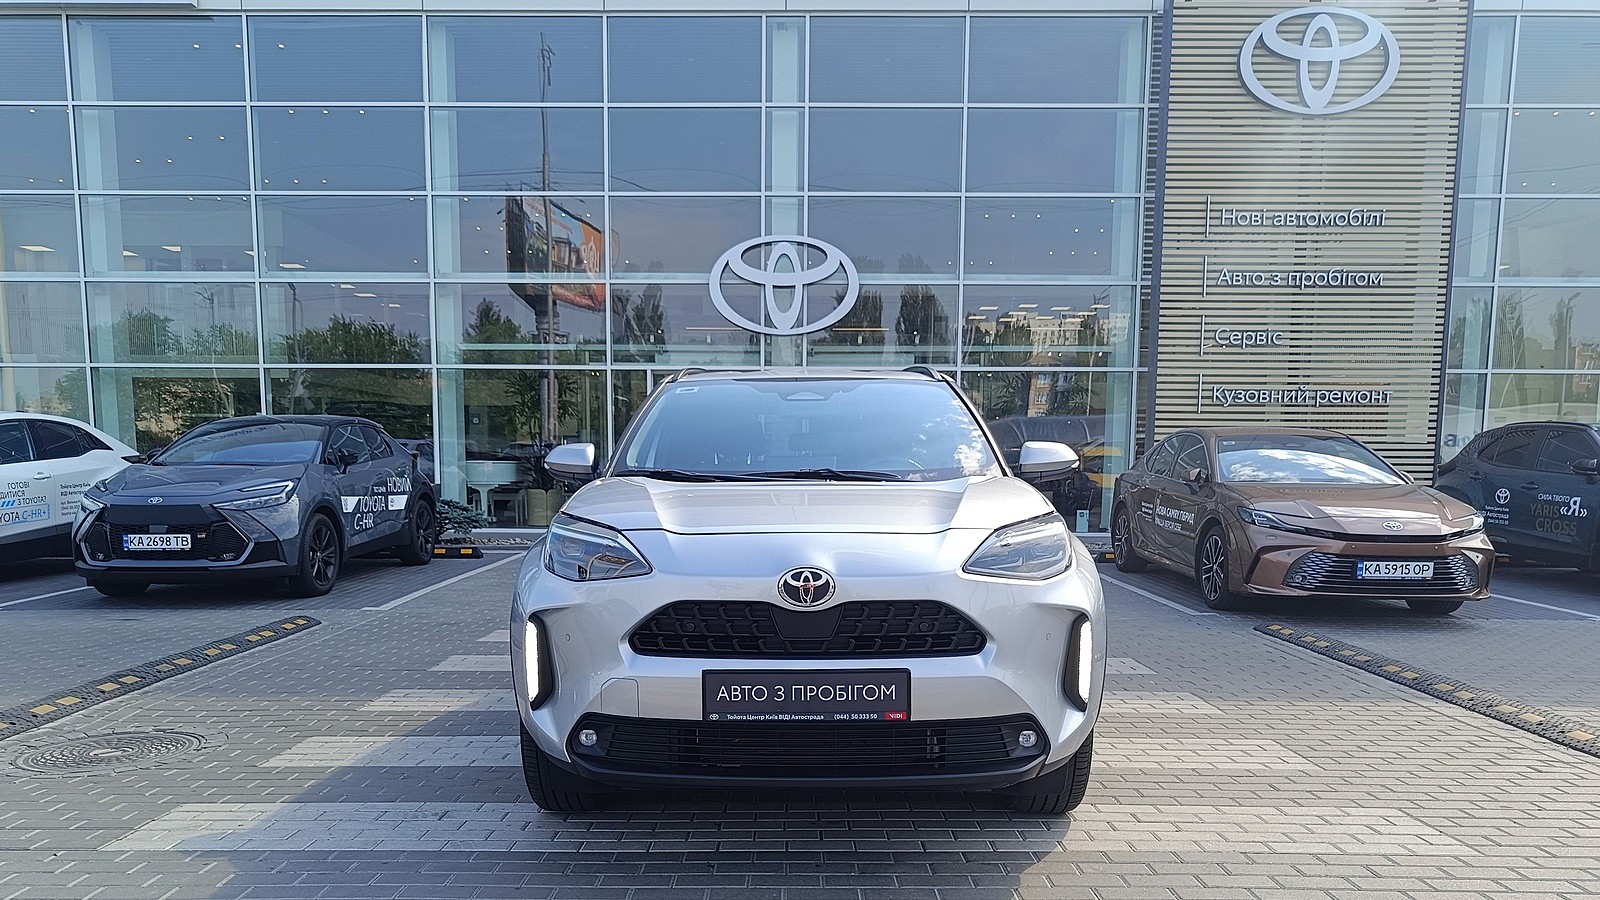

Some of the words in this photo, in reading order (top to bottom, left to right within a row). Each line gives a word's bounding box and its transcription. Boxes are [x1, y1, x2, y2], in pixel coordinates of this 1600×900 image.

[1220, 208, 1267, 227] Нові
[1273, 207, 1387, 227] автомобілі
[1217, 268, 1265, 286] Авто
[1271, 272, 1281, 286] з
[1288, 267, 1384, 290] пробігом
[1214, 327, 1284, 349] Сервіс
[1211, 385, 1310, 407] Кузовний
[1315, 390, 1393, 408] ремонт
[7, 481, 30, 490] ГОТОВІ
[359, 495, 386, 512] TOYOTA
[1529, 502, 1560, 518] YARIS
[22, 508, 47, 520] C-HR+
[354, 513, 374, 530] C-HR
[1535, 518, 1577, 536] CROSS
[129, 536, 145, 547] KA
[146, 536, 172, 547] 2698
[174, 536, 191, 547] TB
[1364, 563, 1382, 575] KA
[1384, 563, 1411, 575] 5915
[1413, 564, 1430, 575] OP
[716, 685, 768, 701] АВТО
[773, 685, 785, 701] З
[792, 684, 896, 701] ПРОБІГОМ
